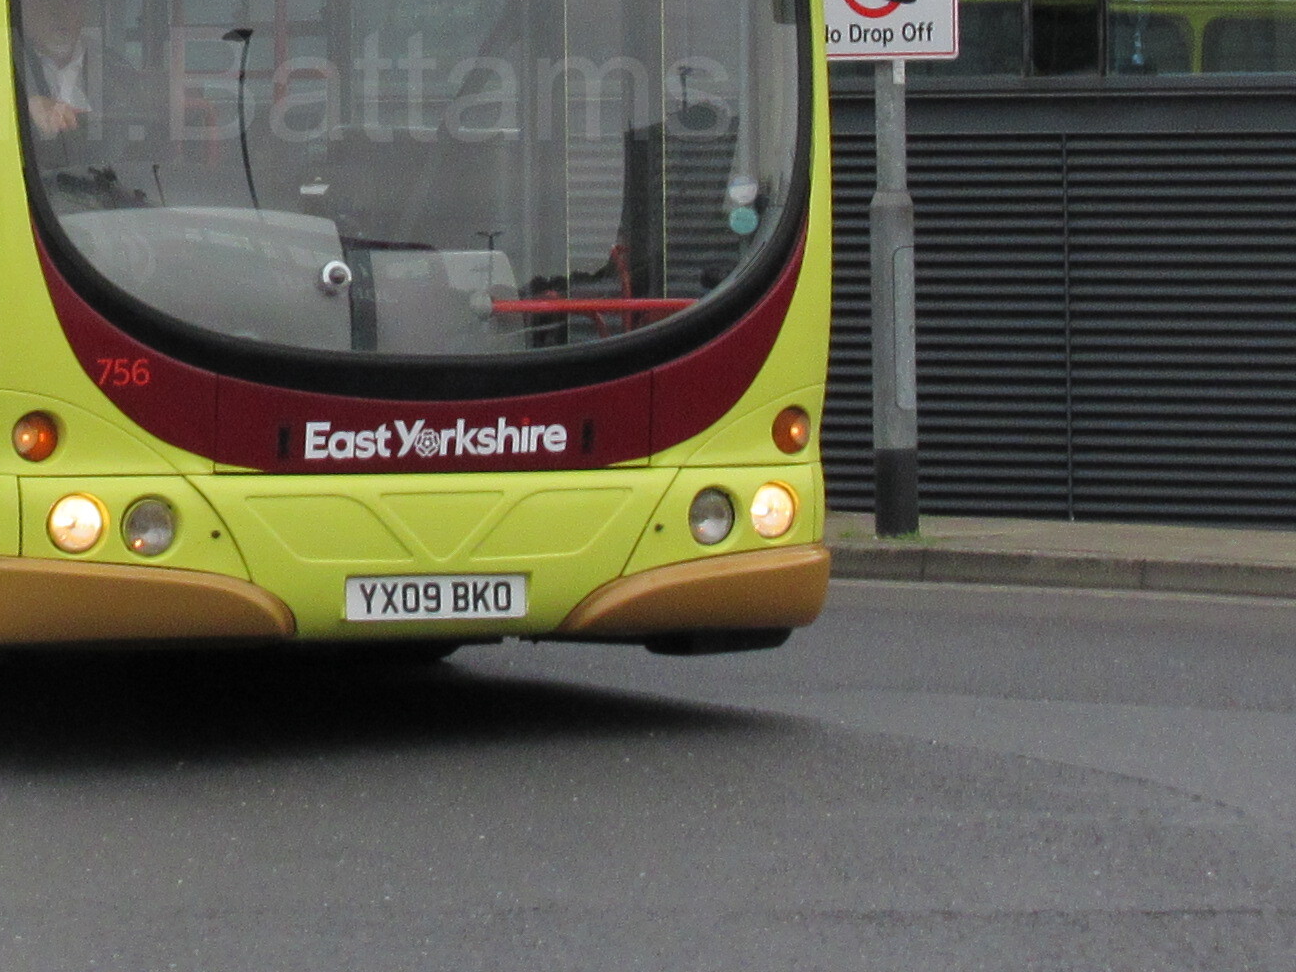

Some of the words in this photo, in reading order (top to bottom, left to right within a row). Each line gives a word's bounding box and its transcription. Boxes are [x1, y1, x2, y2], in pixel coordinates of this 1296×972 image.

[849, 23, 894, 47] Drop
[902, 20, 934, 42] Off
[97, 357, 151, 386] 756
[304, 420, 392, 459] East
[393, 416, 568, 458] Yorkshire
[359, 581, 442, 614] YX09
